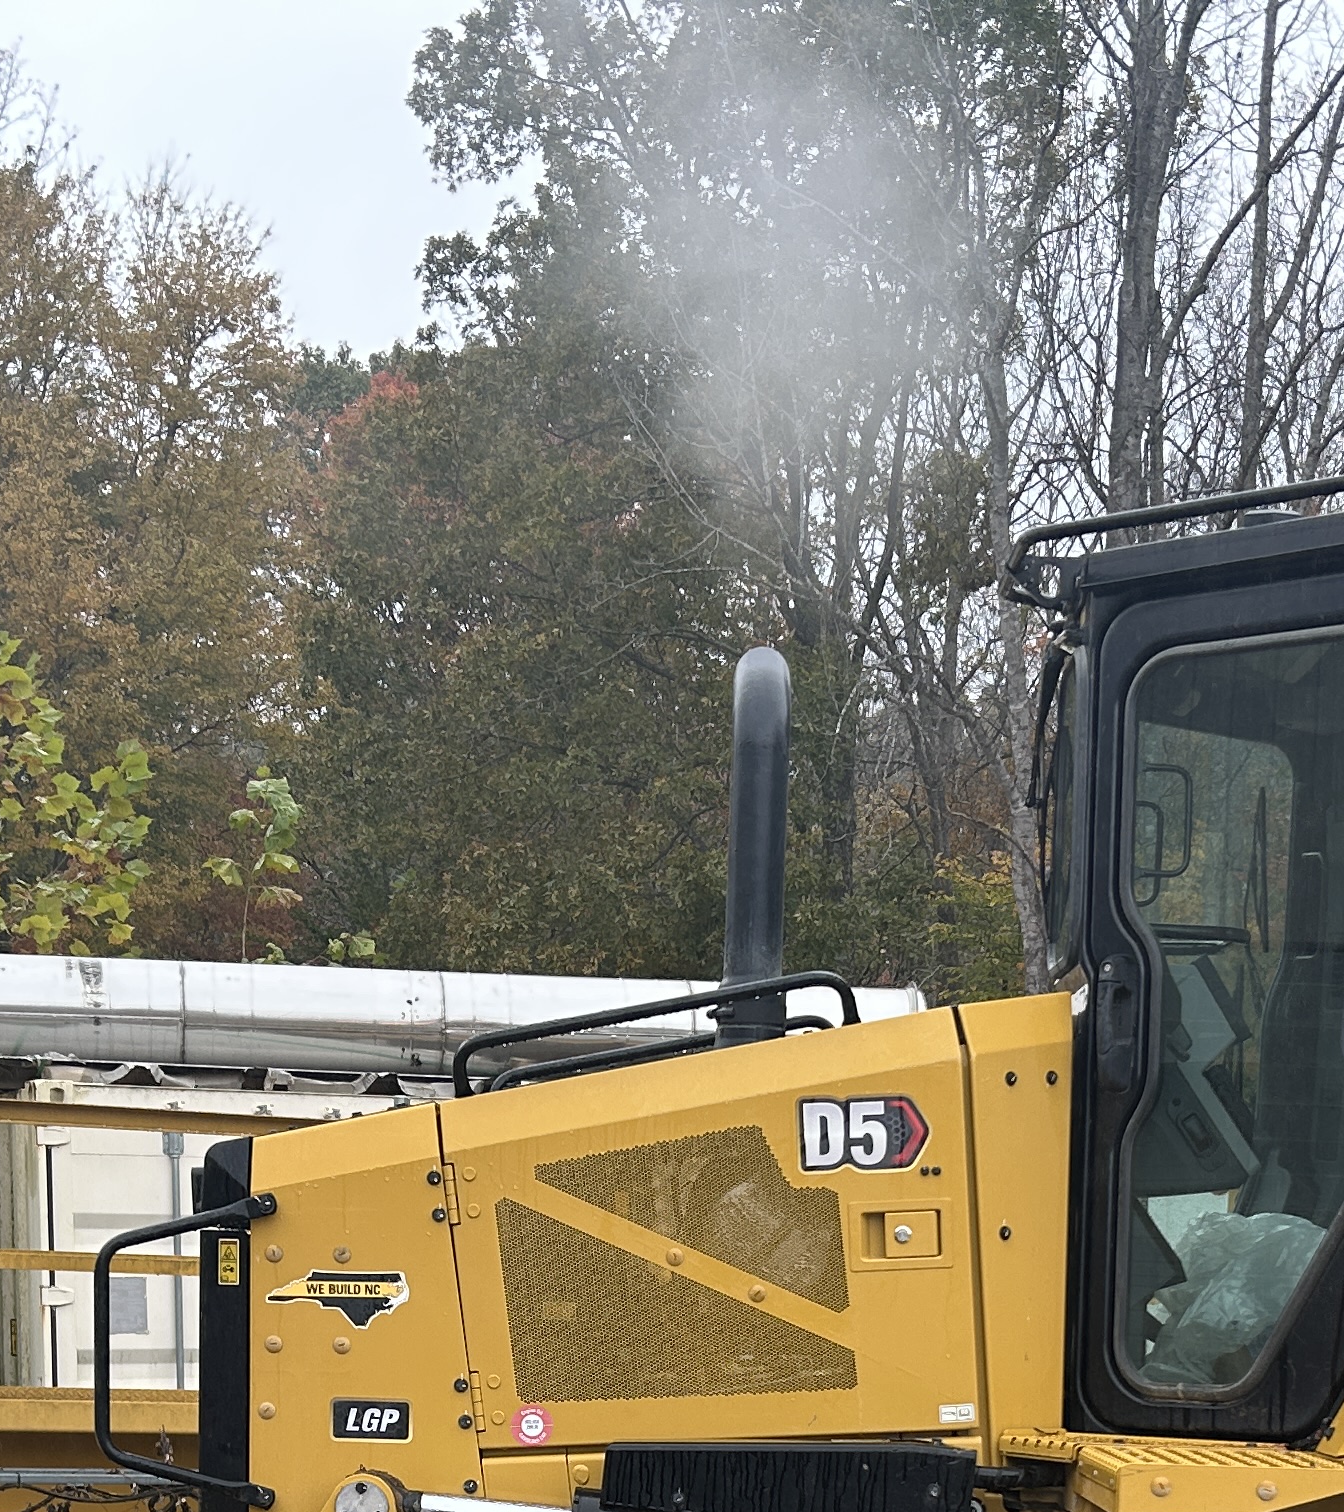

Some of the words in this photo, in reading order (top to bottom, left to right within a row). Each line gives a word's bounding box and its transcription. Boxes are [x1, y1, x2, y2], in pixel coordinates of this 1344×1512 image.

[802, 1100, 888, 1167] D5
[306, 1283, 326, 1295] WE
[328, 1283, 361, 1295] BUILD
[364, 1284, 382, 1296] NC
[344, 1407, 401, 1433] LGP
